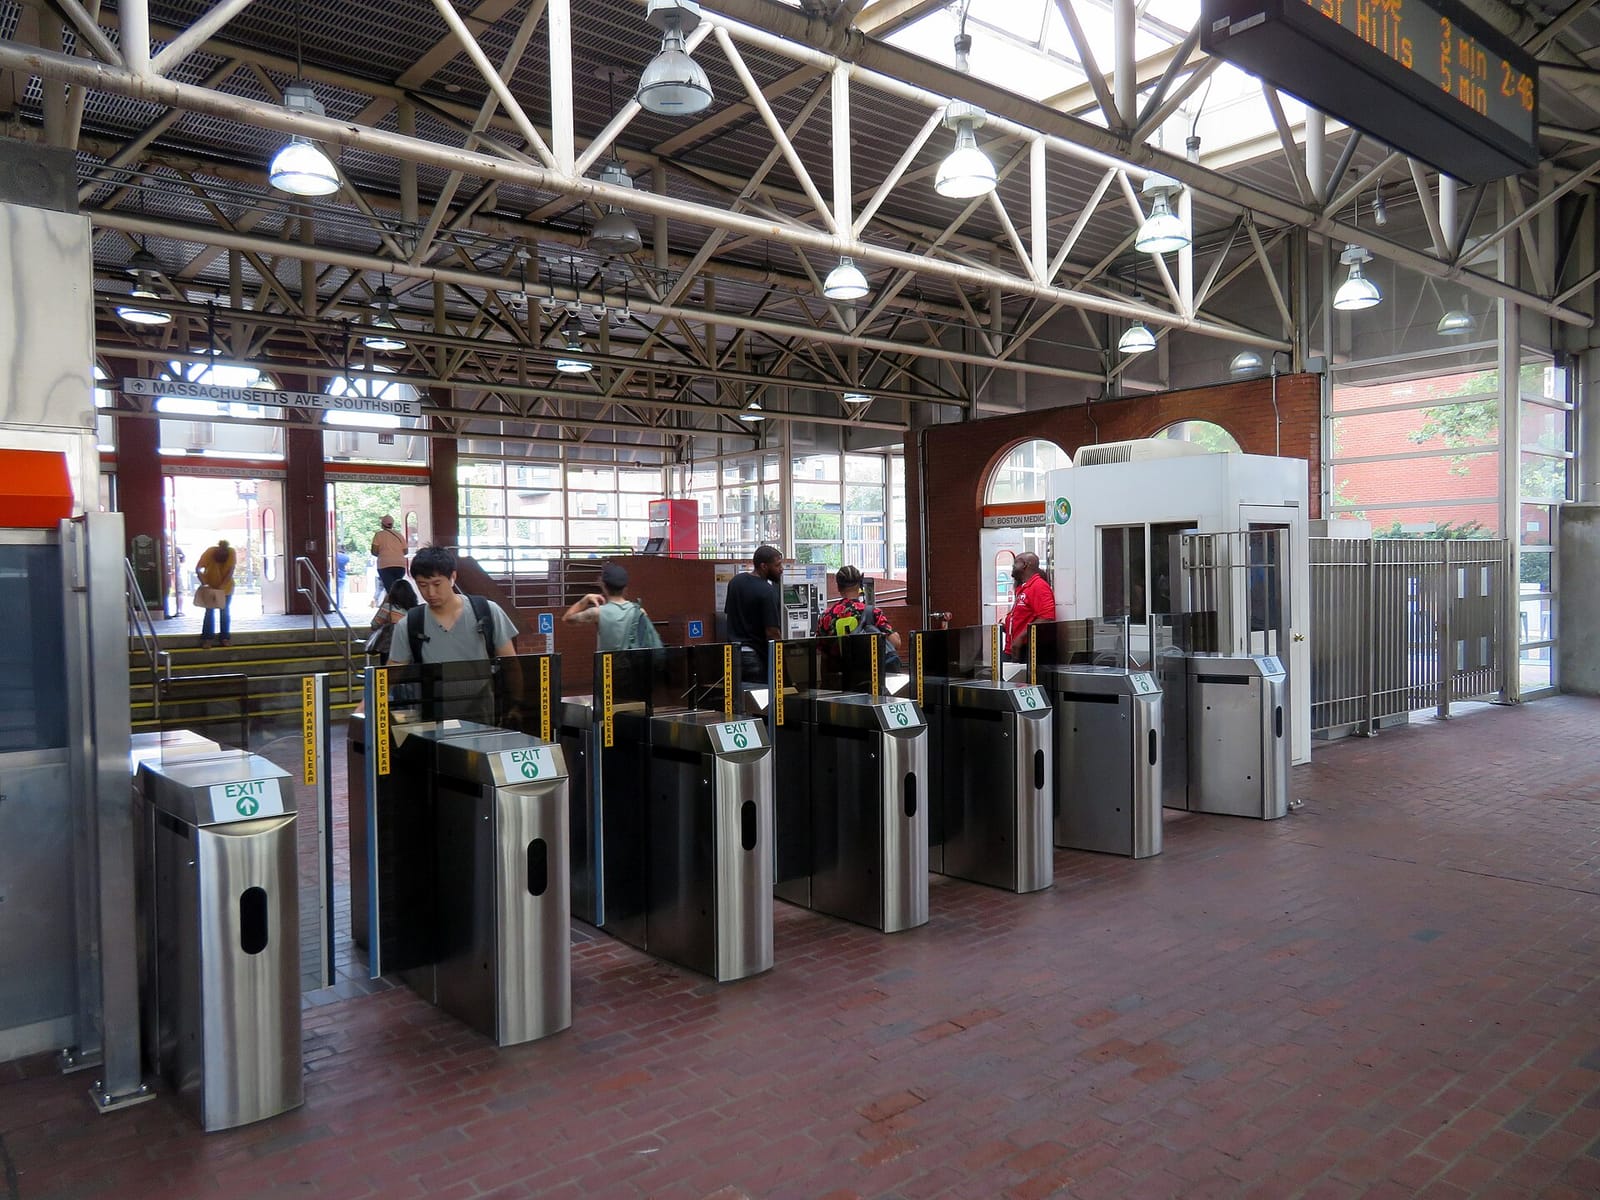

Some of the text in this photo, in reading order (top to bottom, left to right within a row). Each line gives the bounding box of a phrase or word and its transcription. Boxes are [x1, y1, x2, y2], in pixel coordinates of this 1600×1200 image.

[1459, 36, 1487, 81] min
[1440, 53, 1452, 94] 5
[1458, 75, 1488, 117] min
[152, 381, 289, 405] MASSACHUSETTS
[334, 398, 412, 414] SOUTHSIDE
[997, 515, 1023, 524] BOSTON
[1018, 687, 1035, 698] EXIT
[379, 702, 387, 735] HANDS
[888, 703, 907, 714] EXIT
[305, 679, 315, 783] KEEP HANDS CLEAR
[724, 722, 748, 735] EXIT
[380, 740, 388, 772] CLEAR
[511, 748, 541, 763] EXIT
[224, 781, 265, 798] EXIT
